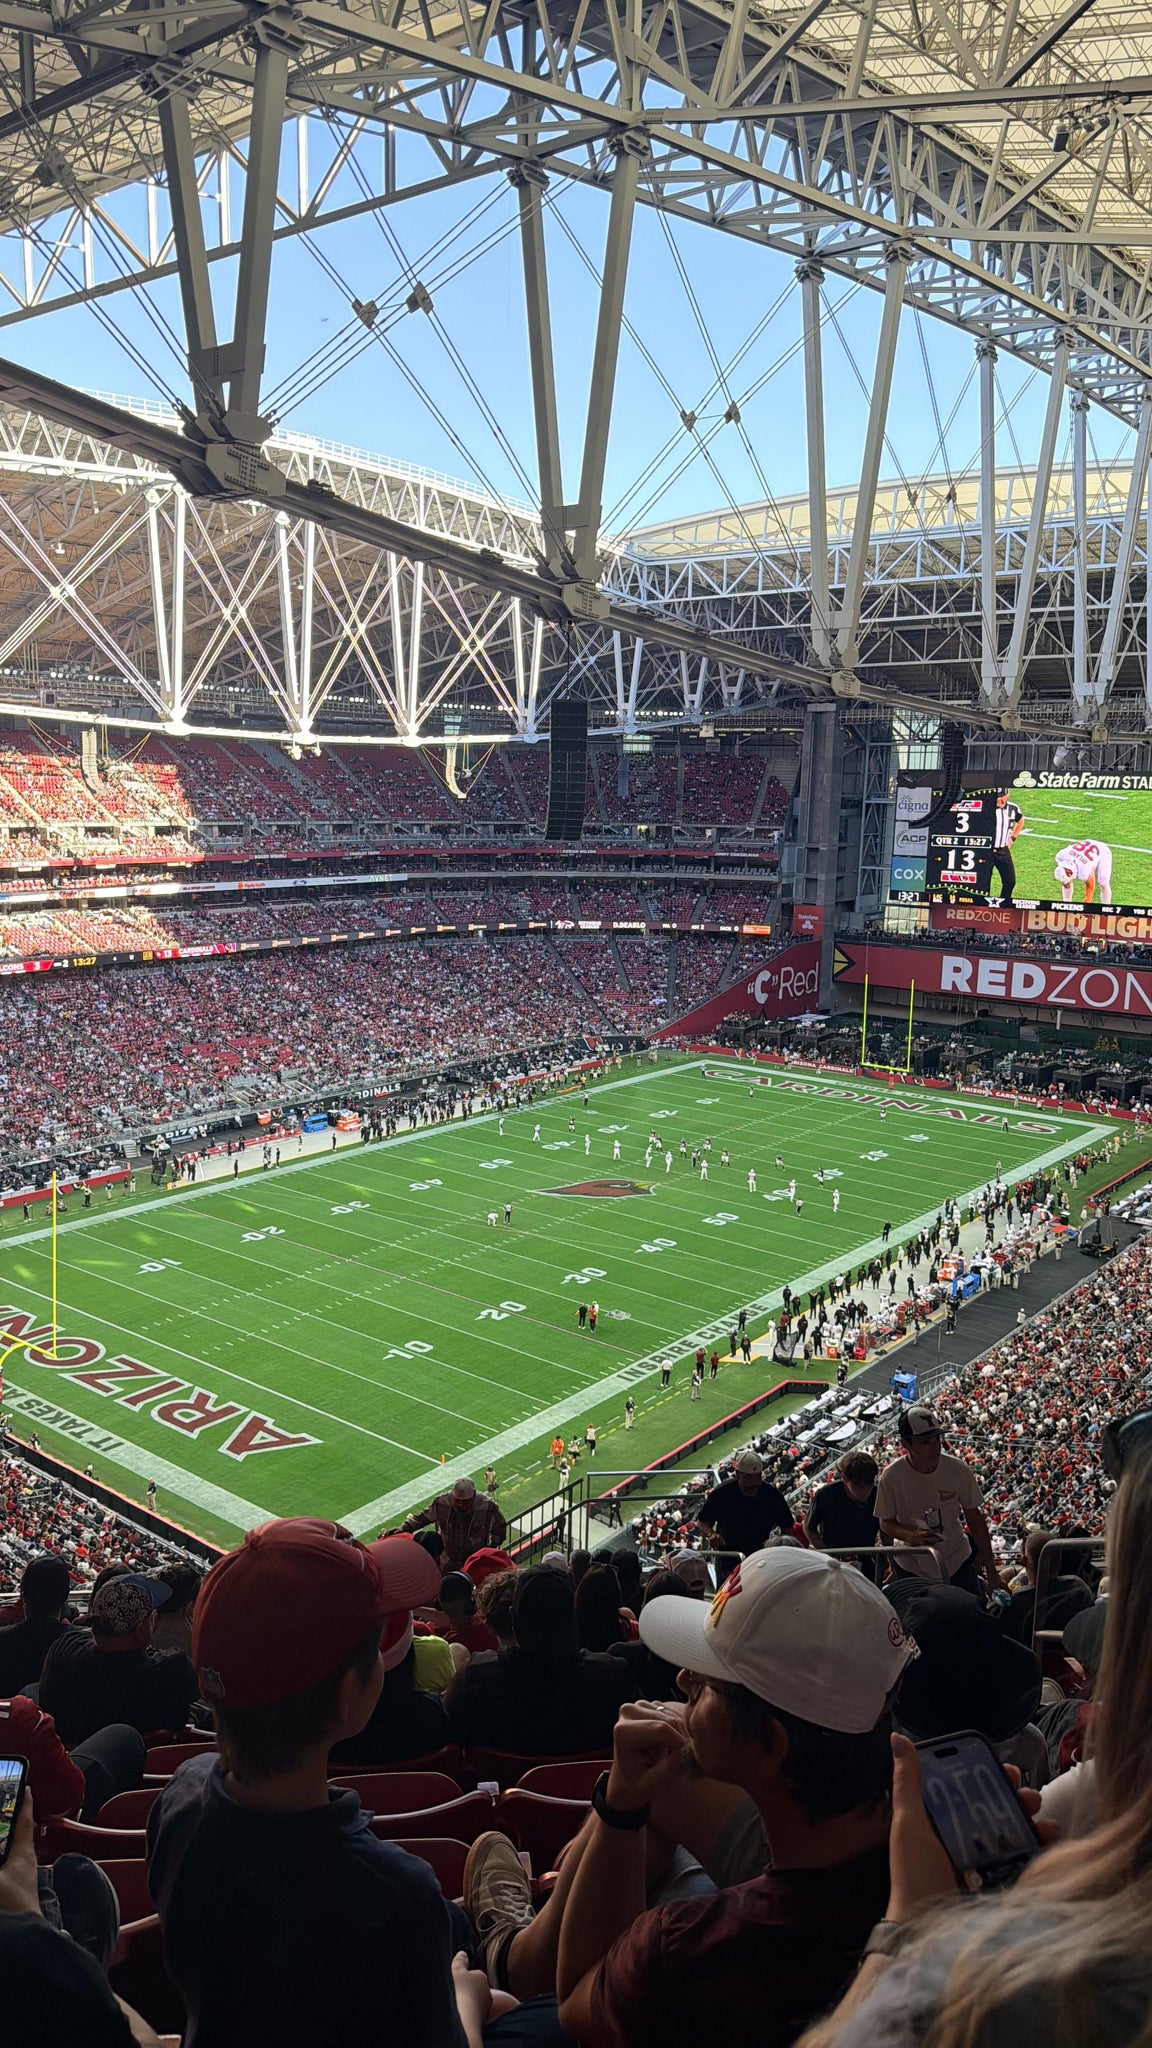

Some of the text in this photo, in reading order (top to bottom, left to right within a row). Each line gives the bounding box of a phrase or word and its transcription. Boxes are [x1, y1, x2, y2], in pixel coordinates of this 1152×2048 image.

[955, 812, 970, 833] 3
[935, 837, 987, 846] QTR 2 13:27
[946, 849, 976, 870] 13
[893, 868, 924, 880] COX
[898, 891, 920, 902] 13:27
[1051, 902, 1085, 912] PICKENS
[946, 908, 1012, 924] REDZONE
[1027, 909, 1087, 933] BUD
[612, 921, 646, 929] D.DEABLO
[178, 945, 214, 954] CARDINALS
[62, 959, 69, 967] 2
[73, 957, 97, 966] 13:27
[778, 961, 819, 1000] Red
[705, 1069, 1062, 1135] CARDINALS
[961, 1085, 1036, 1102] ARIZON CARDNALS
[702, 1212, 740, 1226] 50
[641, 1238, 678, 1254] 40
[565, 1267, 607, 1284] 30
[483, 1301, 527, 1321] 20
[393, 1340, 434, 1360] 10
[616, 1303, 771, 1383] INSPIRE CHANGE
[15, 1399, 87, 1440] TAKES
[87, 1433, 125, 1453] IT
